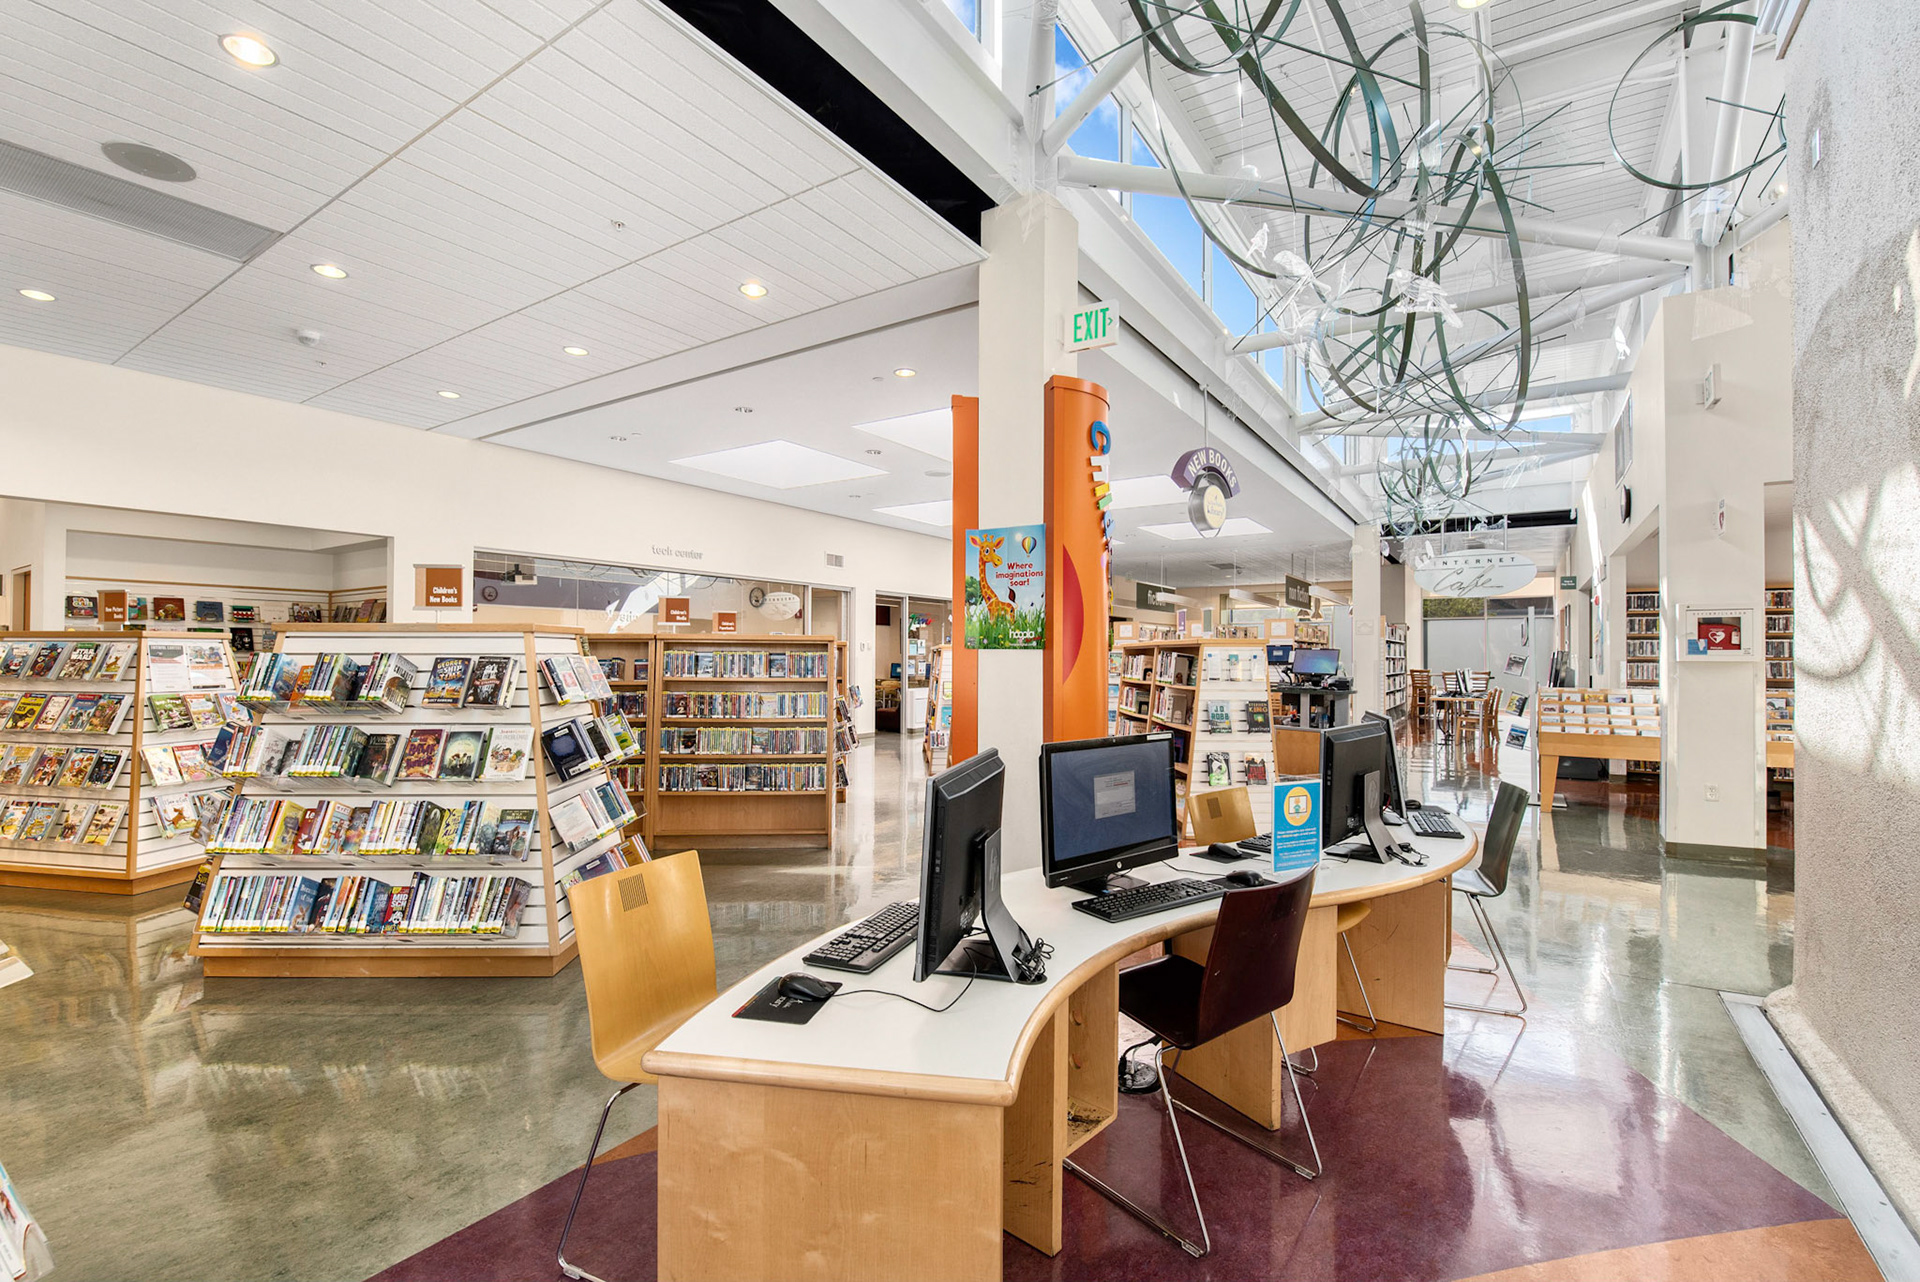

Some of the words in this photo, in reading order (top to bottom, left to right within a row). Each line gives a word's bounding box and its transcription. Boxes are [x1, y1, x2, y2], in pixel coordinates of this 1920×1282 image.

[1073, 307, 1109, 343] EXIT
[1188, 449, 1207, 478] NEW
[1208, 449, 1237, 488] BOOKS
[651, 544, 673, 556] tech
[674, 549, 704, 560] center
[1007, 562, 1033, 571] Where
[1433, 556, 1516, 568] INTERNET
[995, 571, 1044, 581] imaginations
[1009, 579, 1030, 587] soar!
[432, 586, 457, 595] Children's
[429, 595, 440, 603] New
[441, 595, 457, 603] Books
[1009, 628, 1035, 640] hoopla
[70, 653, 93, 661] WARS
[437, 660, 462, 669] GEORGE
[443, 665, 462, 673] SHIP
[439, 672, 462, 681] TIME
[392, 893, 409, 901] MID
[391, 900, 407, 908] SCH
